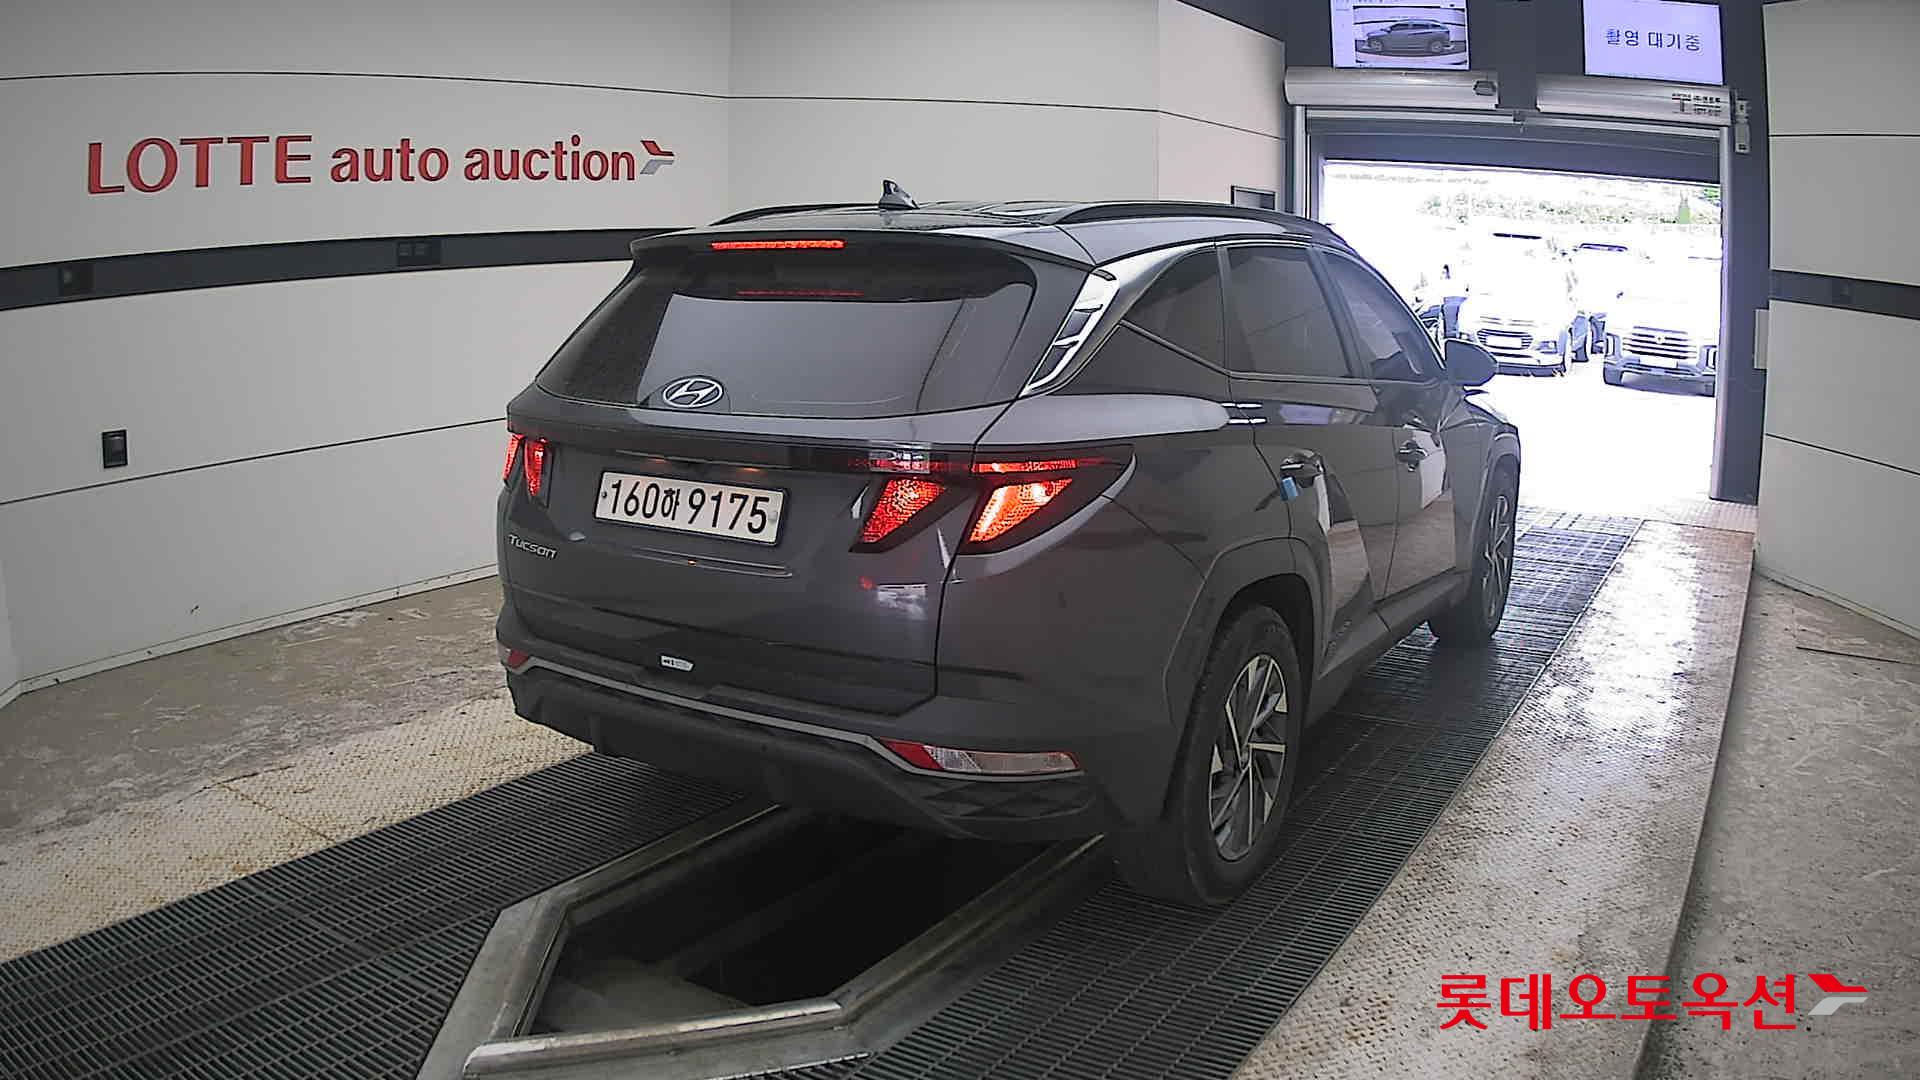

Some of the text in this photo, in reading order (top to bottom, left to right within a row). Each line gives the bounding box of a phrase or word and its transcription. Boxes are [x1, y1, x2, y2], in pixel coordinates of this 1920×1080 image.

[88, 135, 637, 195] LOTTE auto auction
[611, 479, 770, 534] 160하 9175
